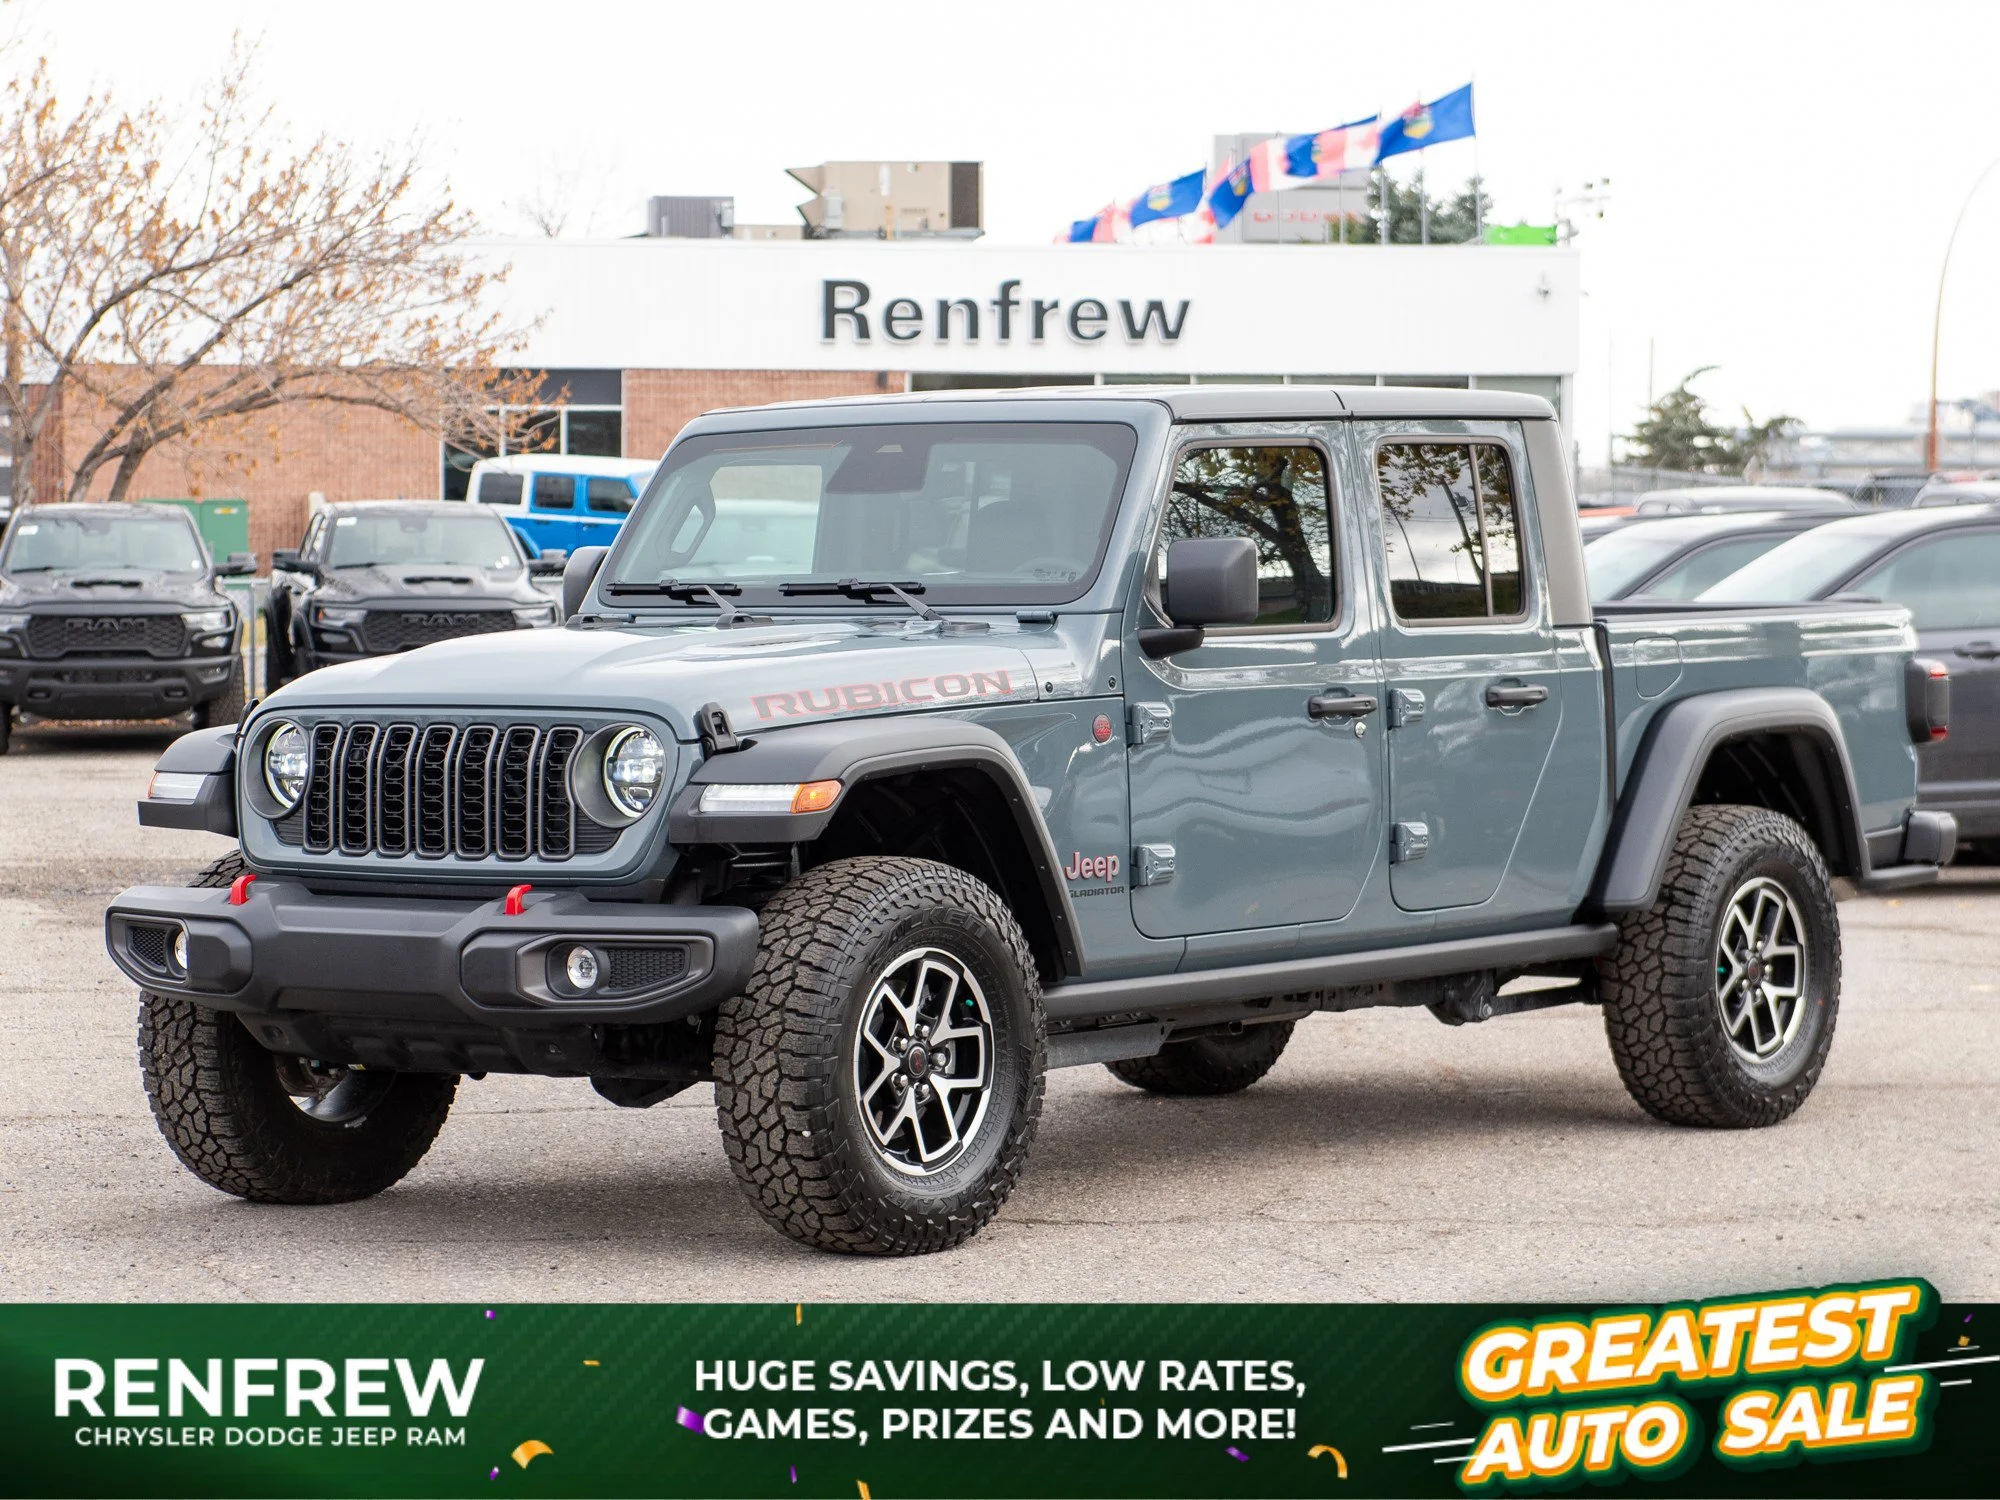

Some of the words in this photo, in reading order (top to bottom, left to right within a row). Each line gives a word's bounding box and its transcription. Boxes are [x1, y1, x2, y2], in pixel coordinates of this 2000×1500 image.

[824, 280, 1190, 341] Renfrew
[66, 618, 147, 632] RAM
[401, 614, 480, 627] RAM
[751, 670, 1013, 721] RUBICON
[1065, 851, 1120, 882] Jeep
